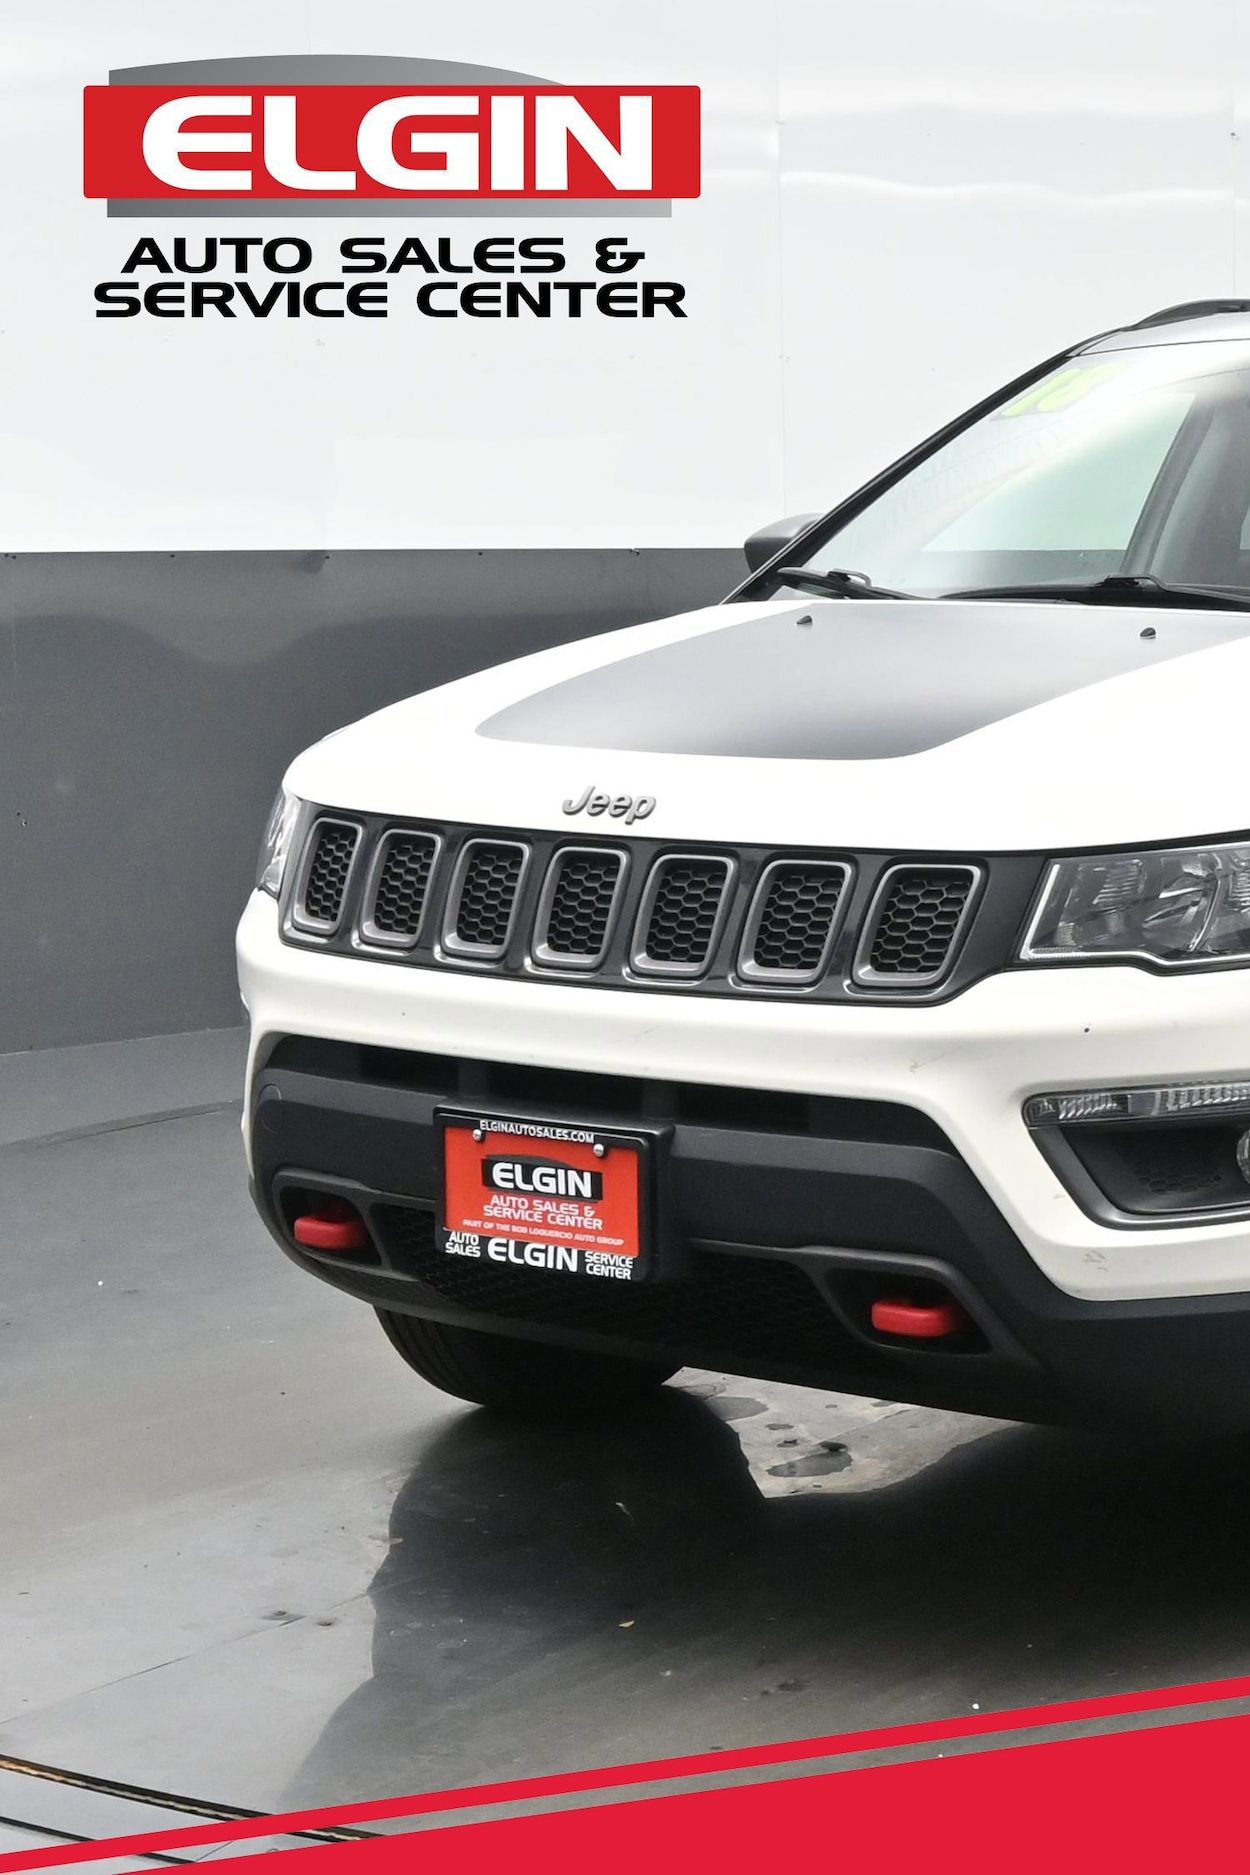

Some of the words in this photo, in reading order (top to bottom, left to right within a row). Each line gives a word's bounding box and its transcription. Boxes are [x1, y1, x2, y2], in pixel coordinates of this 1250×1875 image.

[562, 785, 657, 826] Jeep
[479, 1119, 595, 1144] ELGINAUTOSALES.COM
[492, 1161, 593, 1198] ELGIN
[483, 1205, 543, 1223] SERVICE
[546, 1213, 604, 1230] CENTER
[490, 1194, 529, 1210] AUTO
[533, 1199, 580, 1216] SALES
[583, 1205, 596, 1217] &
[448, 1230, 480, 1246] AUTO
[462, 1219, 482, 1228] PART
[483, 1221, 495, 1230] OF
[496, 1223, 511, 1232] THE
[511, 1225, 528, 1234] BOB
[574, 1233, 596, 1243] AUTO
[596, 1235, 625, 1246] GROUP
[444, 1241, 481, 1258] SALES
[487, 1237, 579, 1273] ELGIN
[584, 1250, 634, 1269] SERVICE
[585, 1263, 632, 1281] CENTER
